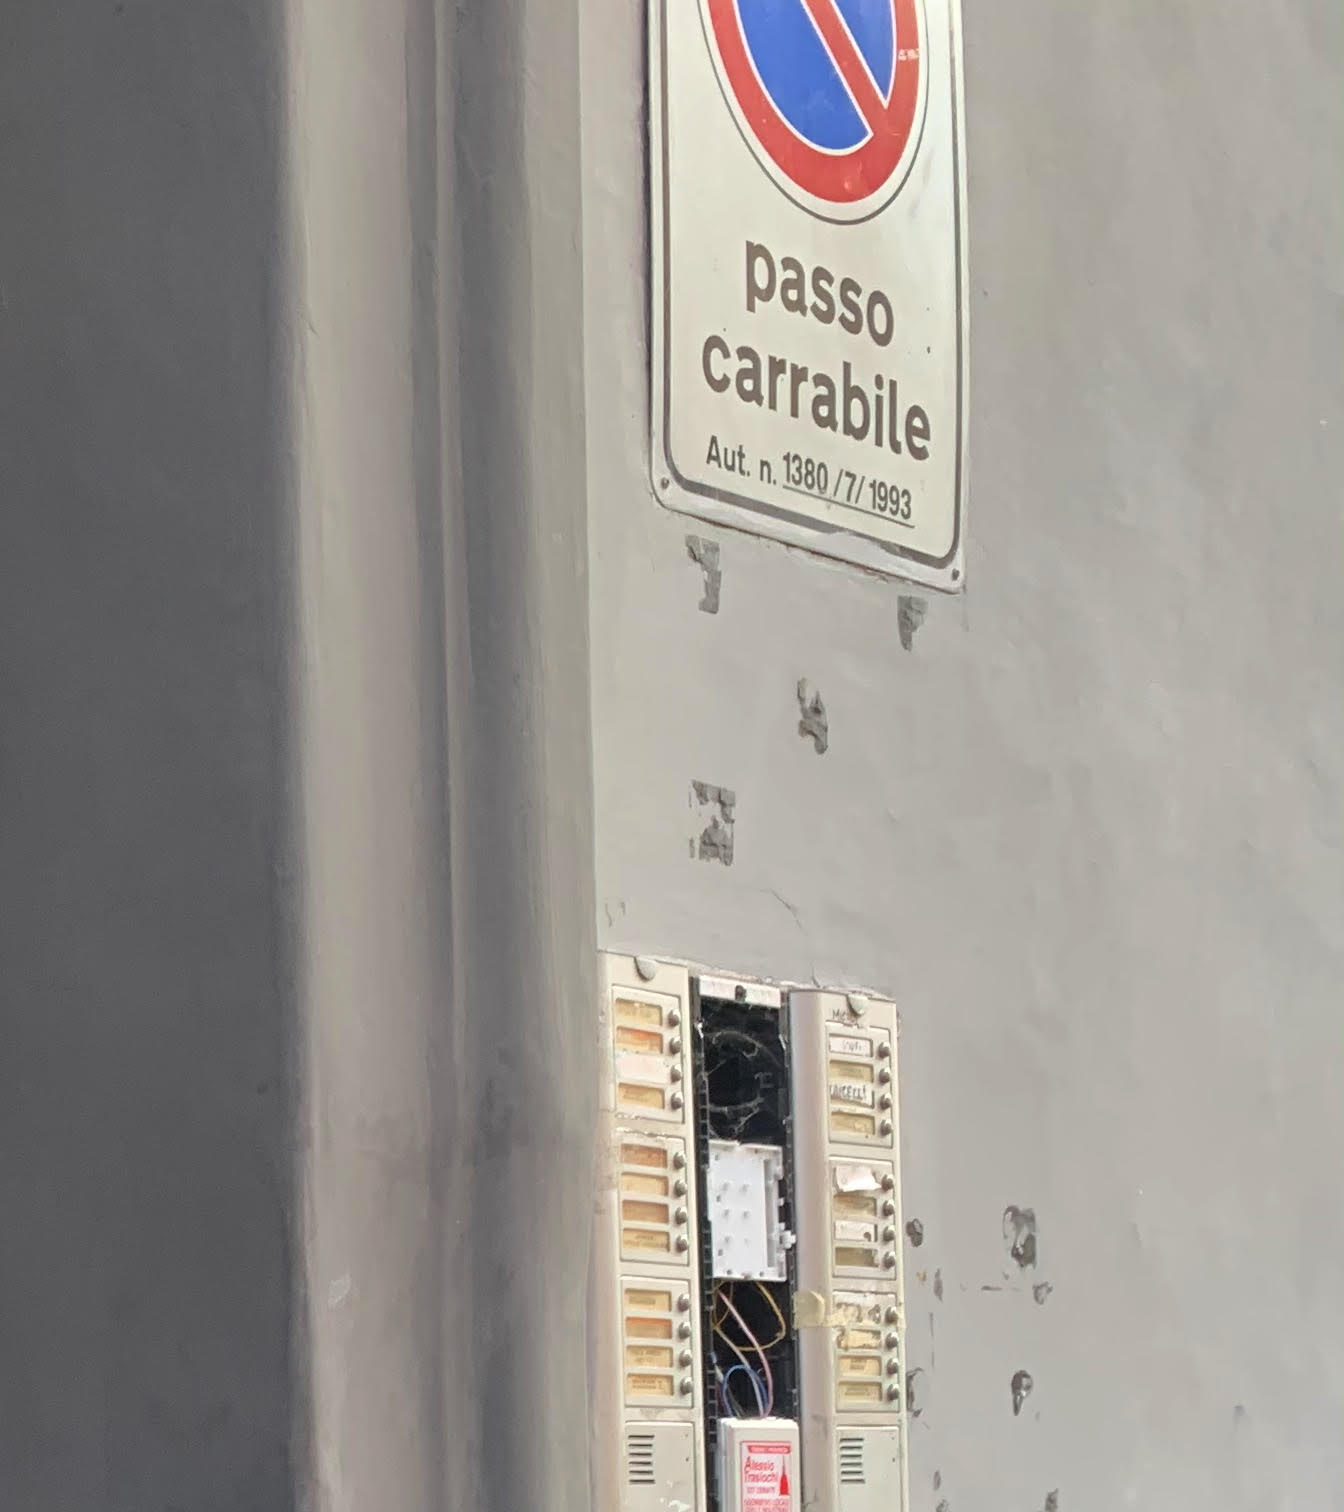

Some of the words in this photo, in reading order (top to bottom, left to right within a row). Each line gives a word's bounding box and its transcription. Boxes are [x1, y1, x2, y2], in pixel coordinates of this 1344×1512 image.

[745, 240, 894, 347] passo
[702, 335, 931, 461] carrabile
[706, 435, 750, 477] Aut.
[759, 459, 777, 485] n.
